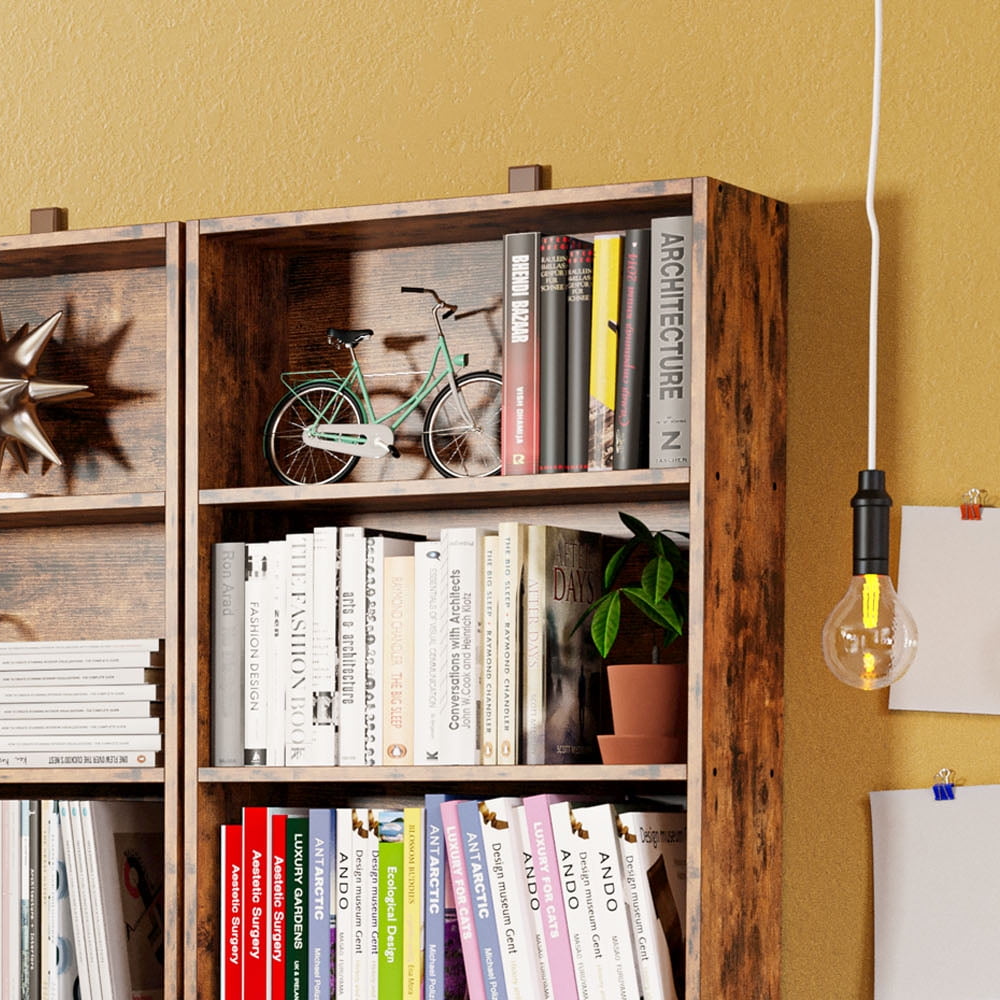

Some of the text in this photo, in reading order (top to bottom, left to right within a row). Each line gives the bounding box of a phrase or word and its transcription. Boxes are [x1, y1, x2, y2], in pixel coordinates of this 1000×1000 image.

[511, 255, 529, 343] BHENDI BAZAAR
[659, 233, 684, 400] ARCHITECTURE
[662, 431, 681, 450] N
[222, 551, 235, 616] Ron Arad
[343, 592, 356, 614] arts
[461, 593, 472, 613] Klotz
[553, 567, 594, 605] DAYS
[250, 602, 259, 711] FASHION DESIGN
[291, 592, 306, 692] FASHION
[343, 633, 357, 705] architecture
[448, 569, 461, 731] Conversations with Architects
[461, 615, 472, 651] Heinrich
[461, 653, 472, 670] and
[391, 672, 403, 689] THE
[391, 691, 403, 705] BIG
[391, 706, 403, 729] SLEEP
[461, 707, 472, 729] John
[250, 850, 262, 959] Aestetic Surgery
[294, 833, 303, 949] LUXURY GARDENS
[314, 838, 324, 920] ANTARCTIC
[339, 852, 349, 910] ANDO
[354, 850, 363, 884] Design
[429, 825, 440, 914] ANTARCTIC
[446, 825, 472, 940] LUXURY FOR CATS
[466, 832, 489, 920] ANTARCTIC
[492, 842, 517, 955] Design museum Gent
[522, 852, 540, 911] ANDO
[533, 822, 559, 939] LUXURY FOR CATS
[560, 850, 579, 910] ANDO
[599, 852, 617, 912] ANDO
[229, 864, 240, 965] Aestetic Surgery
[272, 856, 284, 962] Aestetic Surgery
[384, 866, 397, 964] Ecological Design
[626, 855, 648, 961] Design museum Gent
